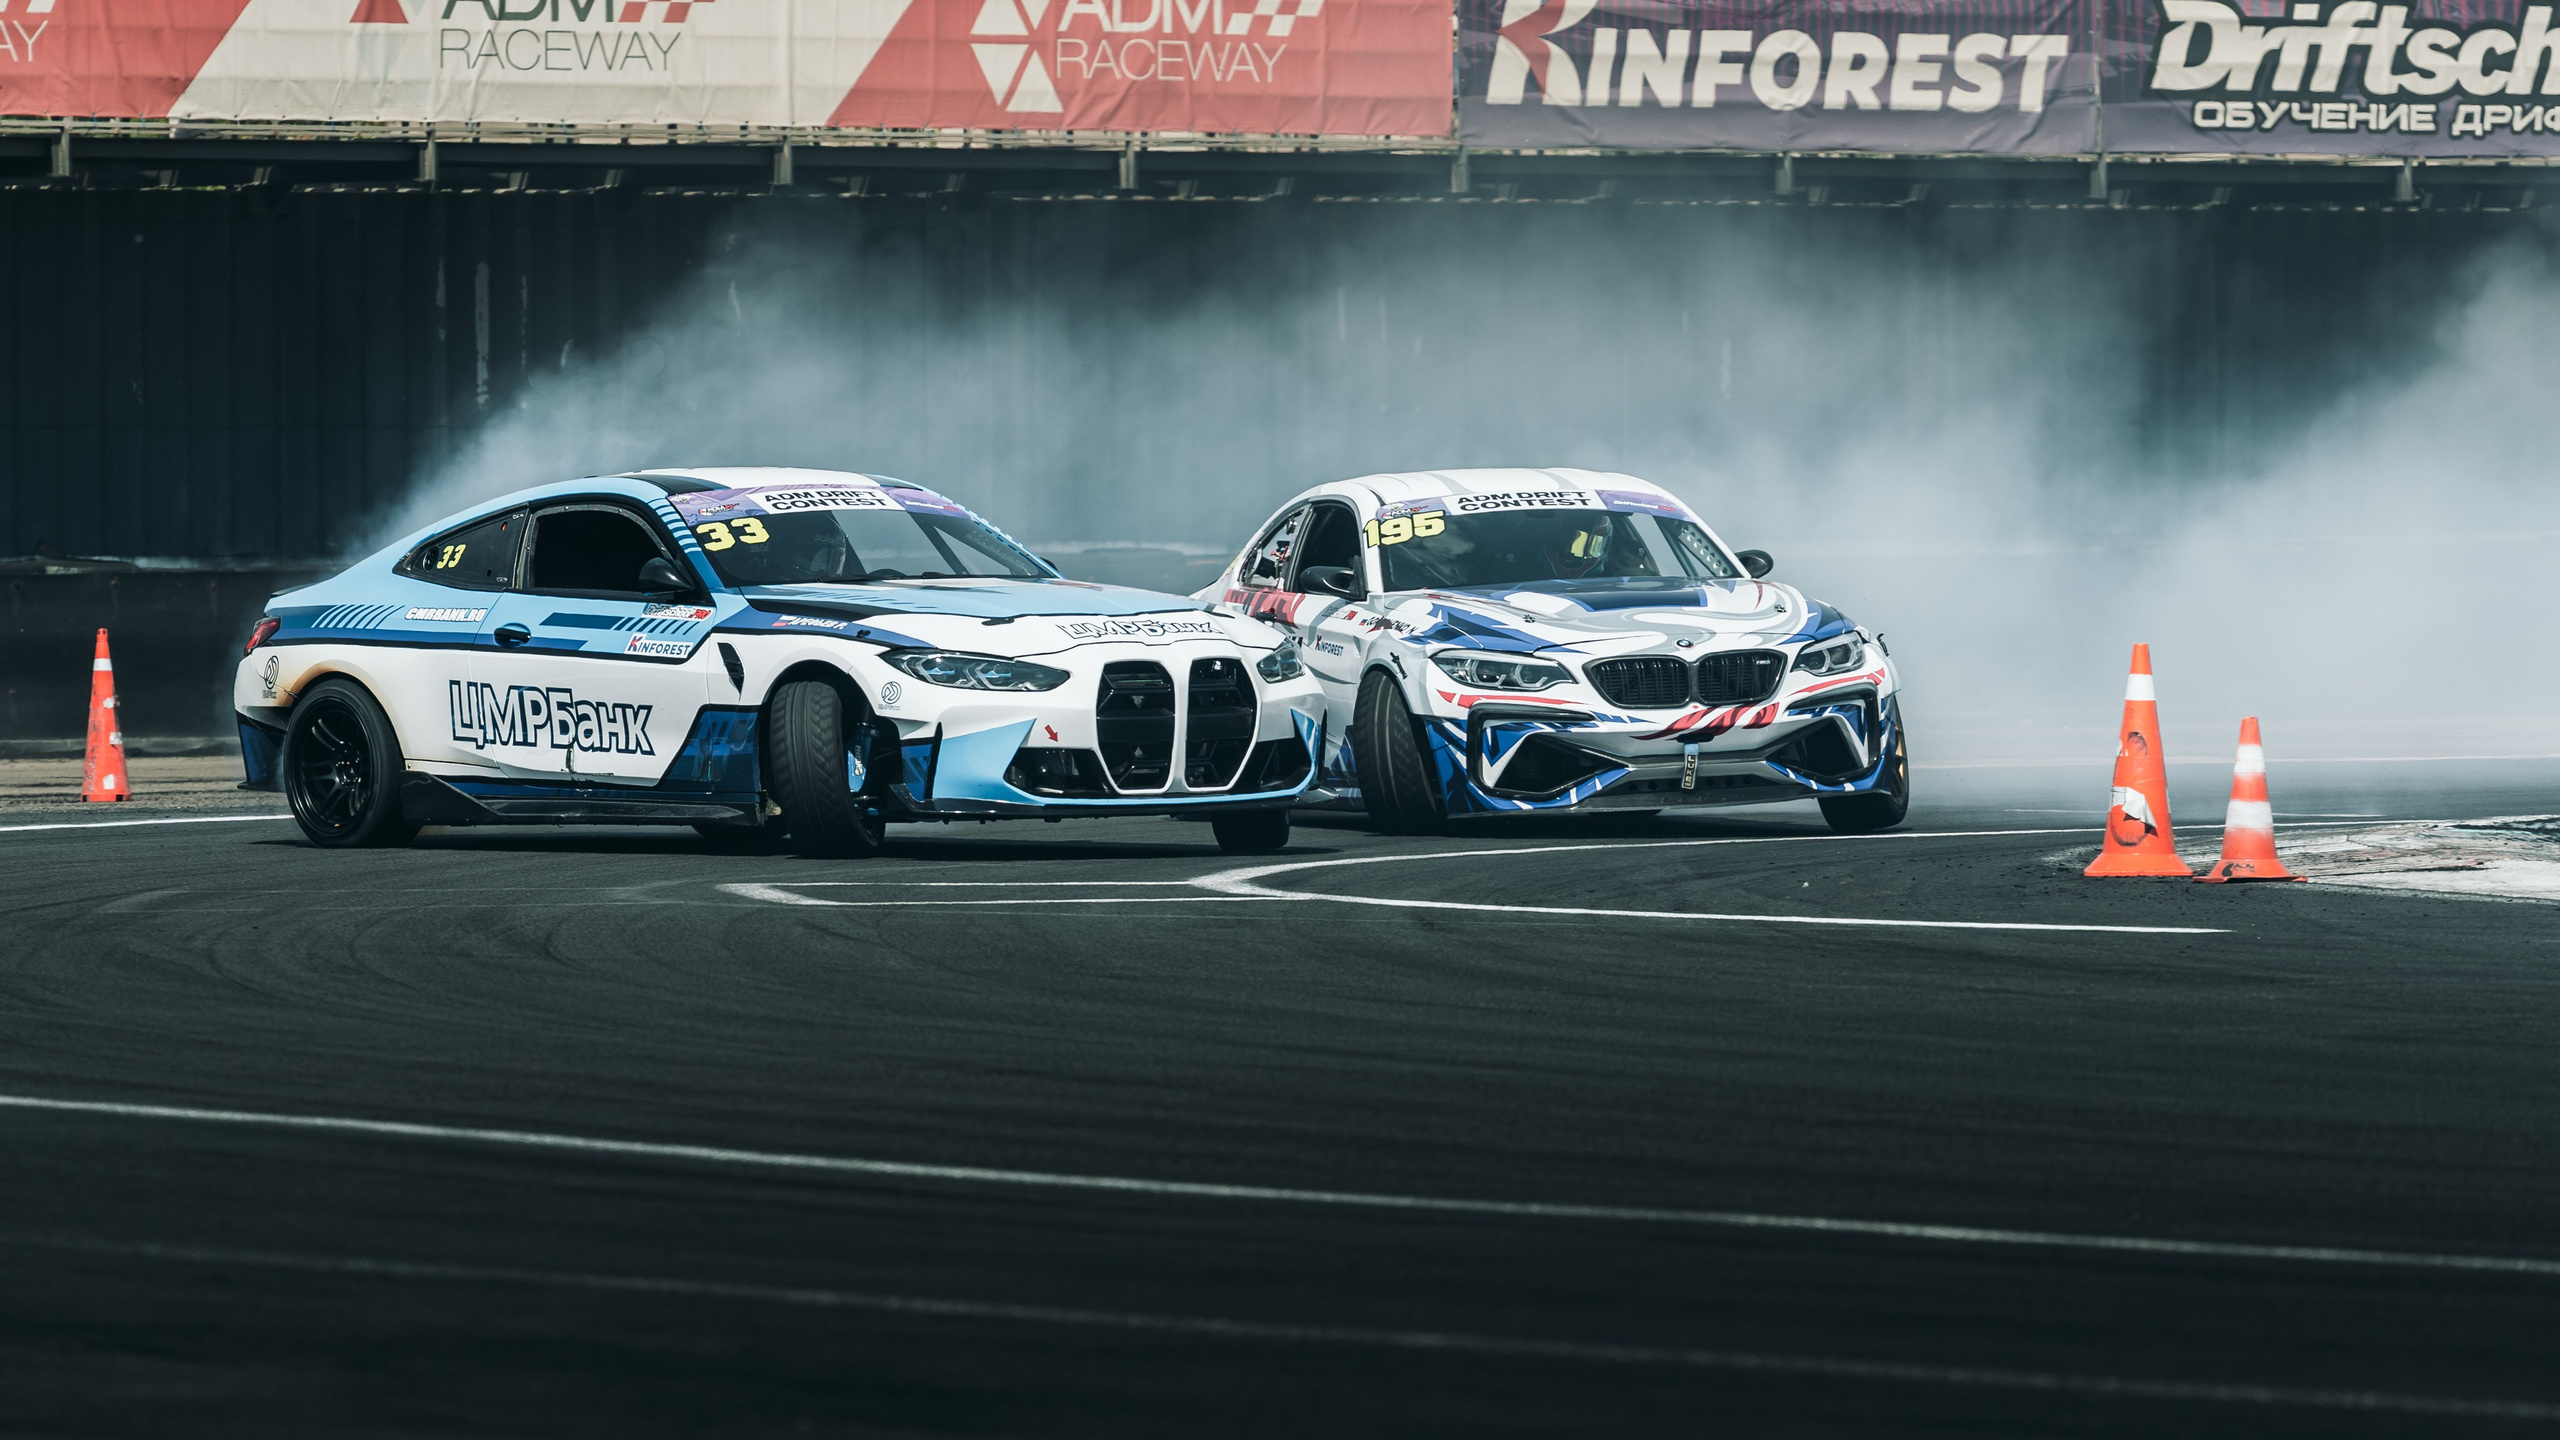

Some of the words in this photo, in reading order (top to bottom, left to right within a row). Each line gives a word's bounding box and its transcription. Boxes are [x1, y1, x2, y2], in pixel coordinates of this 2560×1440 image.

[440, 28, 681, 71] RACEWAY
[1056, 38, 1288, 83] RACEWAY
[2194, 100, 2437, 131] ОБУЧЕНИЕ
[764, 490, 814, 502] ADM
[815, 490, 877, 499] DRIFT
[771, 497, 887, 511] CONTEST
[1457, 493, 1512, 504] ADM
[1515, 491, 1586, 499] DRIFT
[1460, 498, 1591, 511] CONTEST
[696, 517, 770, 551] 33
[1364, 510, 1446, 548] 195
[436, 544, 466, 569] 33
[405, 607, 488, 623] CMRBANK.RU
[627, 635, 691, 656] KINFOREST
[449, 680, 656, 756] ЦМРБанк
